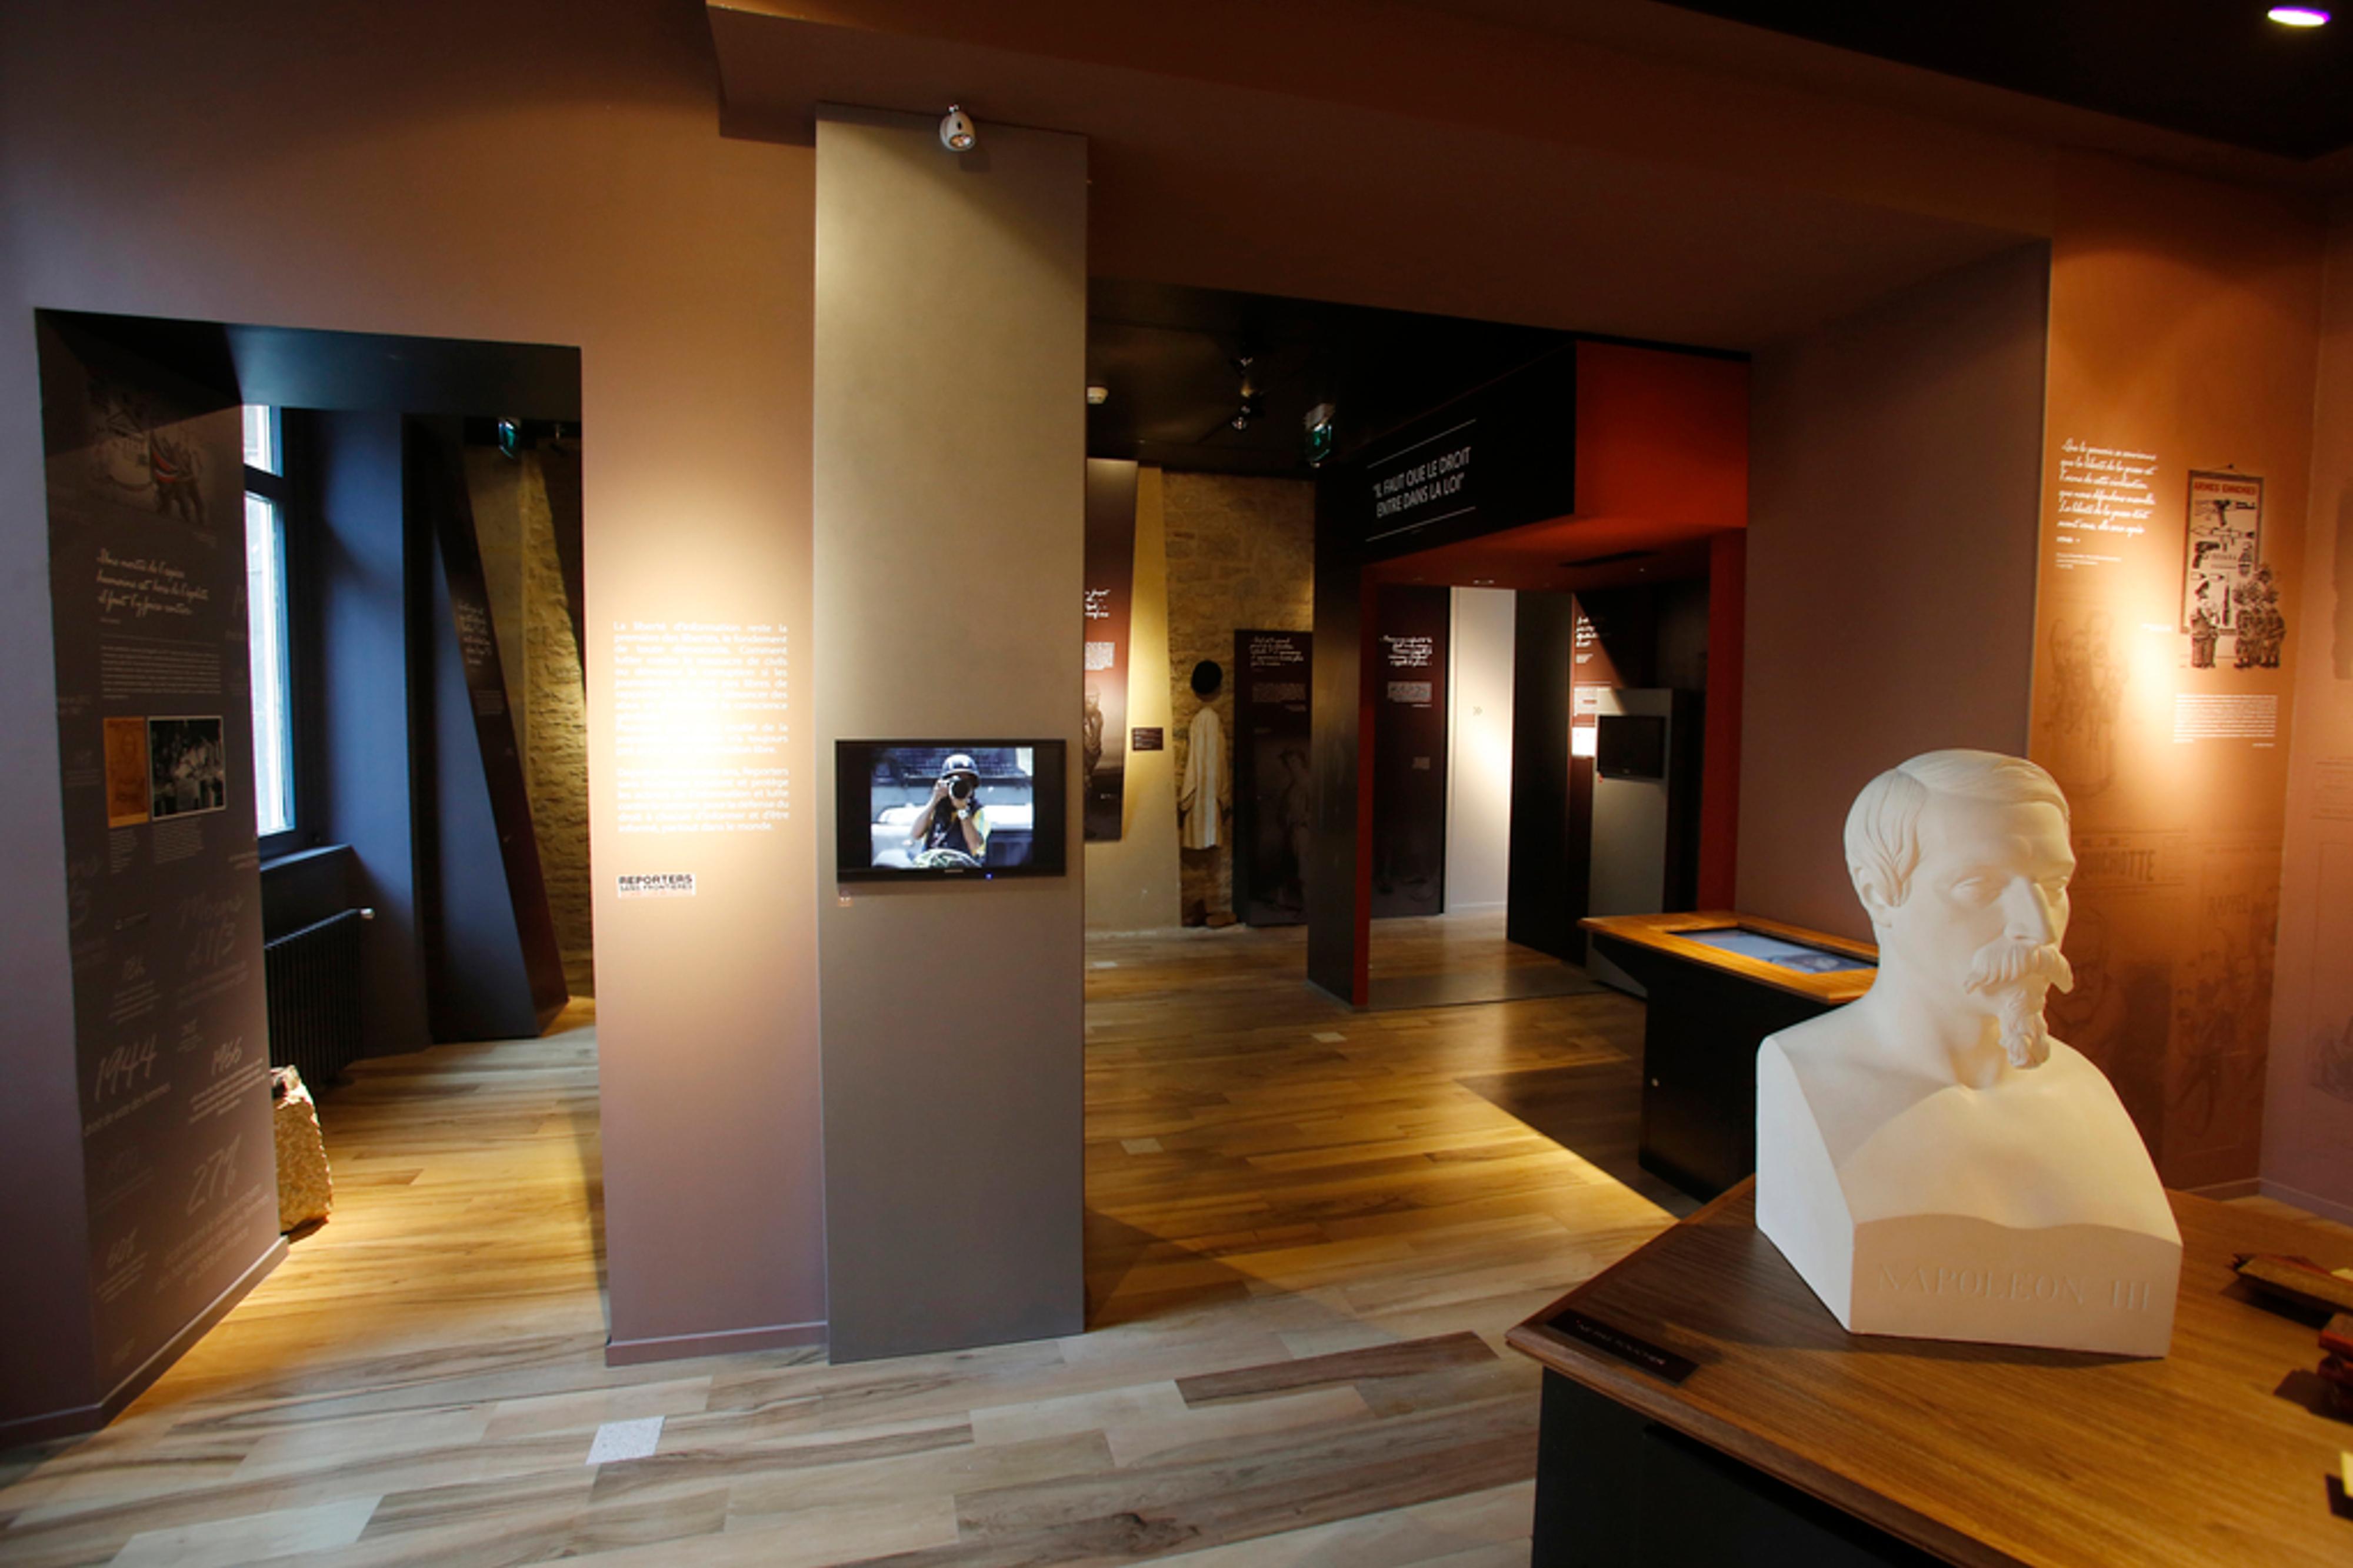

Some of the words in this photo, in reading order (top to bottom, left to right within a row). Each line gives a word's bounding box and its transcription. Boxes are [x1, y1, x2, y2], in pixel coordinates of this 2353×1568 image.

[1406, 465, 1425, 487] QUE
[1427, 460, 1437, 478] LE
[1439, 446, 1471, 474] DROIT
[1404, 485, 1428, 509] DANS
[1429, 481, 1441, 500] LA
[612, 621, 626, 630] La
[633, 621, 666, 630] liberté
[673, 622, 741, 632] d'information
[778, 624, 788, 633] la
[618, 874, 692, 884] REPORTERS
[95, 1032, 158, 1103] 1944
[1877, 1261, 2087, 1307] NAPOLEON
[2109, 1279, 2151, 1312] III
